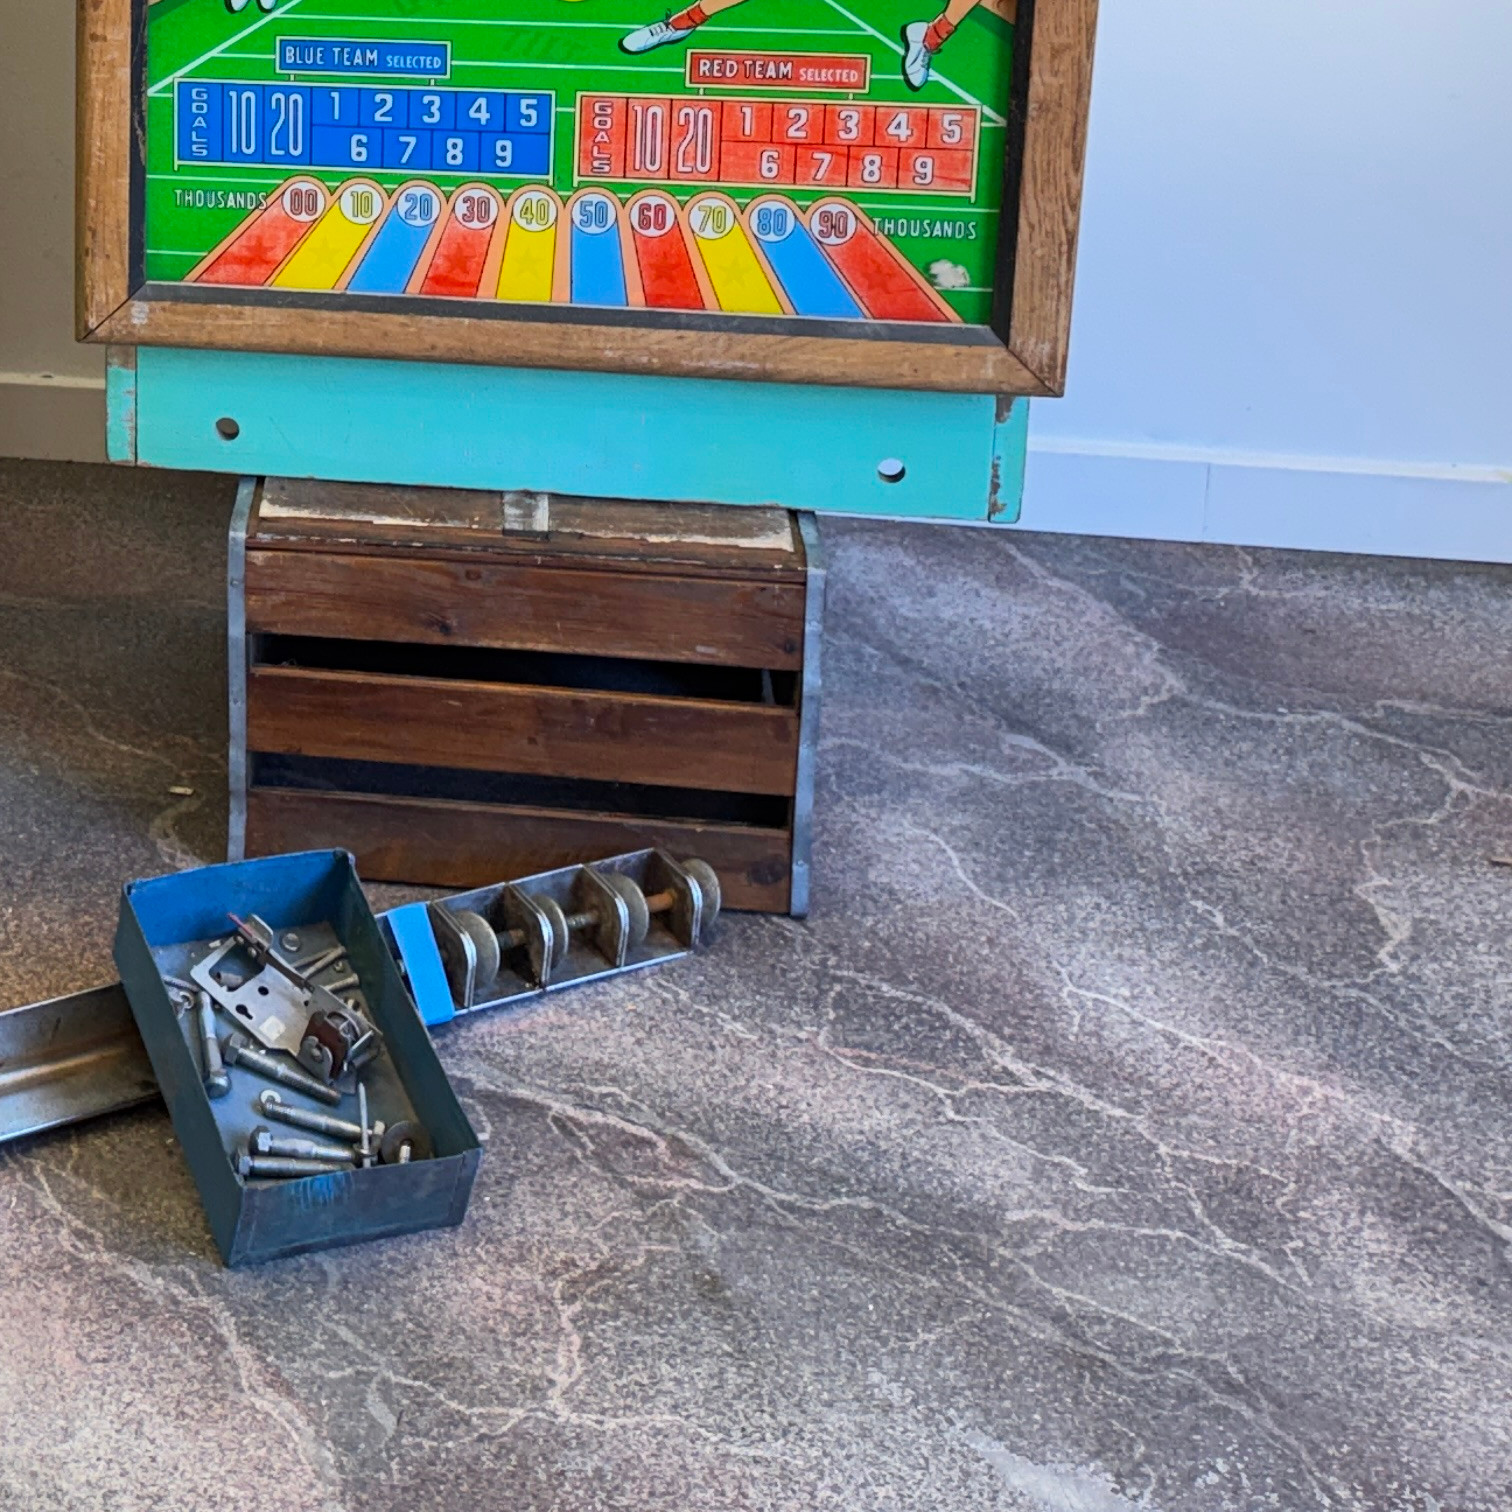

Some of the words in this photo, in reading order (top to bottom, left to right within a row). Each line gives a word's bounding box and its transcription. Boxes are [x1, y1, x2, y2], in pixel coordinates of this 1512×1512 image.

[286, 47, 324, 65] BLUE
[332, 48, 377, 67] TEAM
[387, 57, 441, 69] SELECTED
[699, 59, 737, 78] RED
[744, 61, 792, 79] TEAM
[799, 68, 858, 83] SELECTED
[330, 92, 340, 120] 1
[374, 94, 393, 122] 2
[422, 95, 441, 123] 3
[469, 97, 490, 125] 4
[520, 99, 538, 127] 5
[191, 89, 208, 156] GOALS
[229, 91, 256, 155] 10
[271, 93, 303, 156] 20
[741, 107, 752, 136] 1
[788, 109, 808, 138] 2
[838, 110, 859, 140] 3
[888, 111, 912, 141] 4
[940, 114, 961, 143] 5
[351, 134, 367, 161] 6
[398, 137, 416, 164] 7
[446, 138, 463, 165] 8
[592, 102, 612, 174] GOALS
[634, 105, 662, 171] 10
[676, 108, 712, 174] 20
[496, 140, 512, 167] 9
[760, 149, 779, 178] 6
[811, 152, 832, 180] 7
[862, 154, 882, 183] 8
[913, 156, 934, 184] 9
[175, 189, 267, 210] THOUSANDS
[290, 189, 317, 214] 00
[351, 191, 373, 215] 10
[405, 194, 432, 220] 20
[462, 197, 490, 222] 30
[519, 198, 549, 223] 40
[580, 201, 608, 226] 50
[638, 204, 667, 229] 60
[698, 206, 727, 231] 70
[757, 208, 788, 233] 80
[817, 211, 848, 238] 90
[873, 217, 977, 239] THOUSANDS
